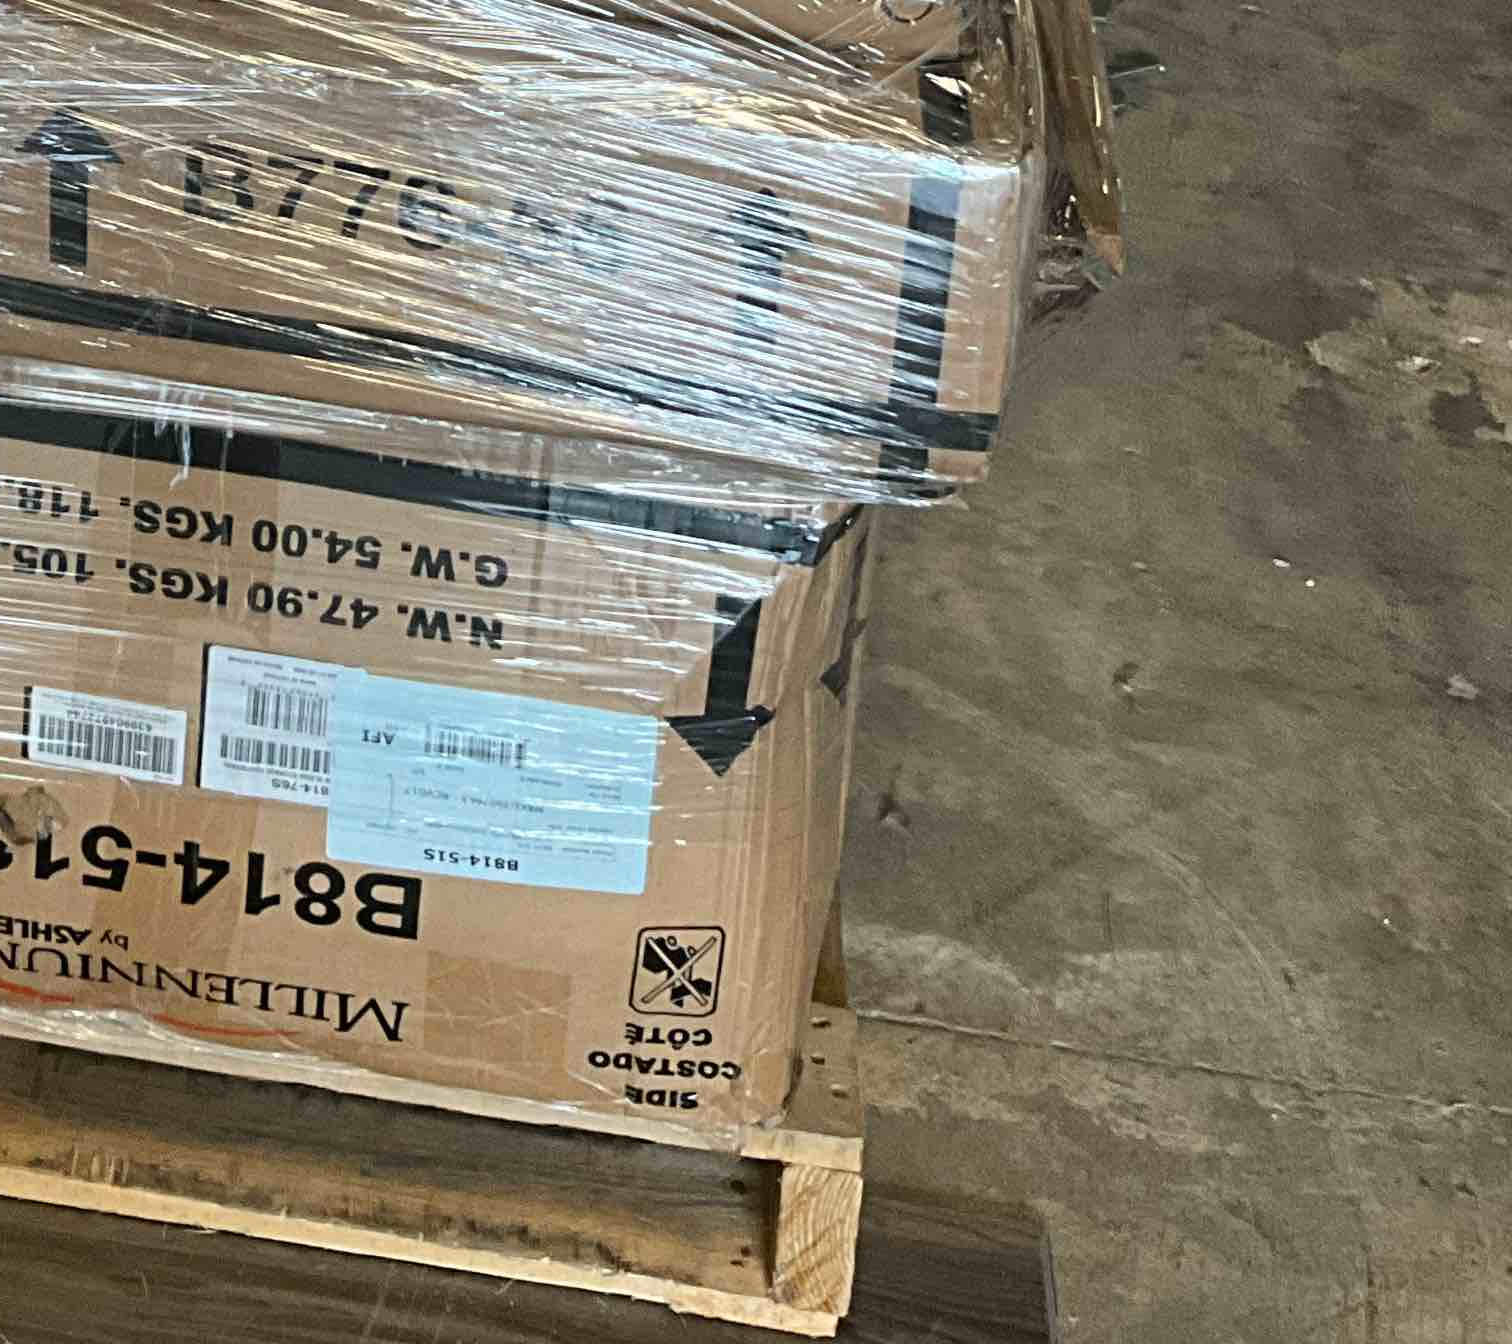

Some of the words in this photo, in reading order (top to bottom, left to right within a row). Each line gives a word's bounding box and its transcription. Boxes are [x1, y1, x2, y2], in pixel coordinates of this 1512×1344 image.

[119, 498, 233, 549] KGS.
[251, 521, 382, 571] 54.00
[400, 541, 509, 590] G.W.
[114, 558, 229, 607] KGS.
[246, 581, 380, 629] 47.90
[396, 603, 505, 650] N.W.
[361, 728, 396, 746] AFI
[271, 777, 330, 797] 814-76S
[423, 848, 519, 872] B814-51S
[101, 922, 130, 952] by
[623, 1020, 714, 1052] CÔTÉ
[587, 1049, 742, 1082] COSTADO
[624, 1083, 700, 1111] SIDE
